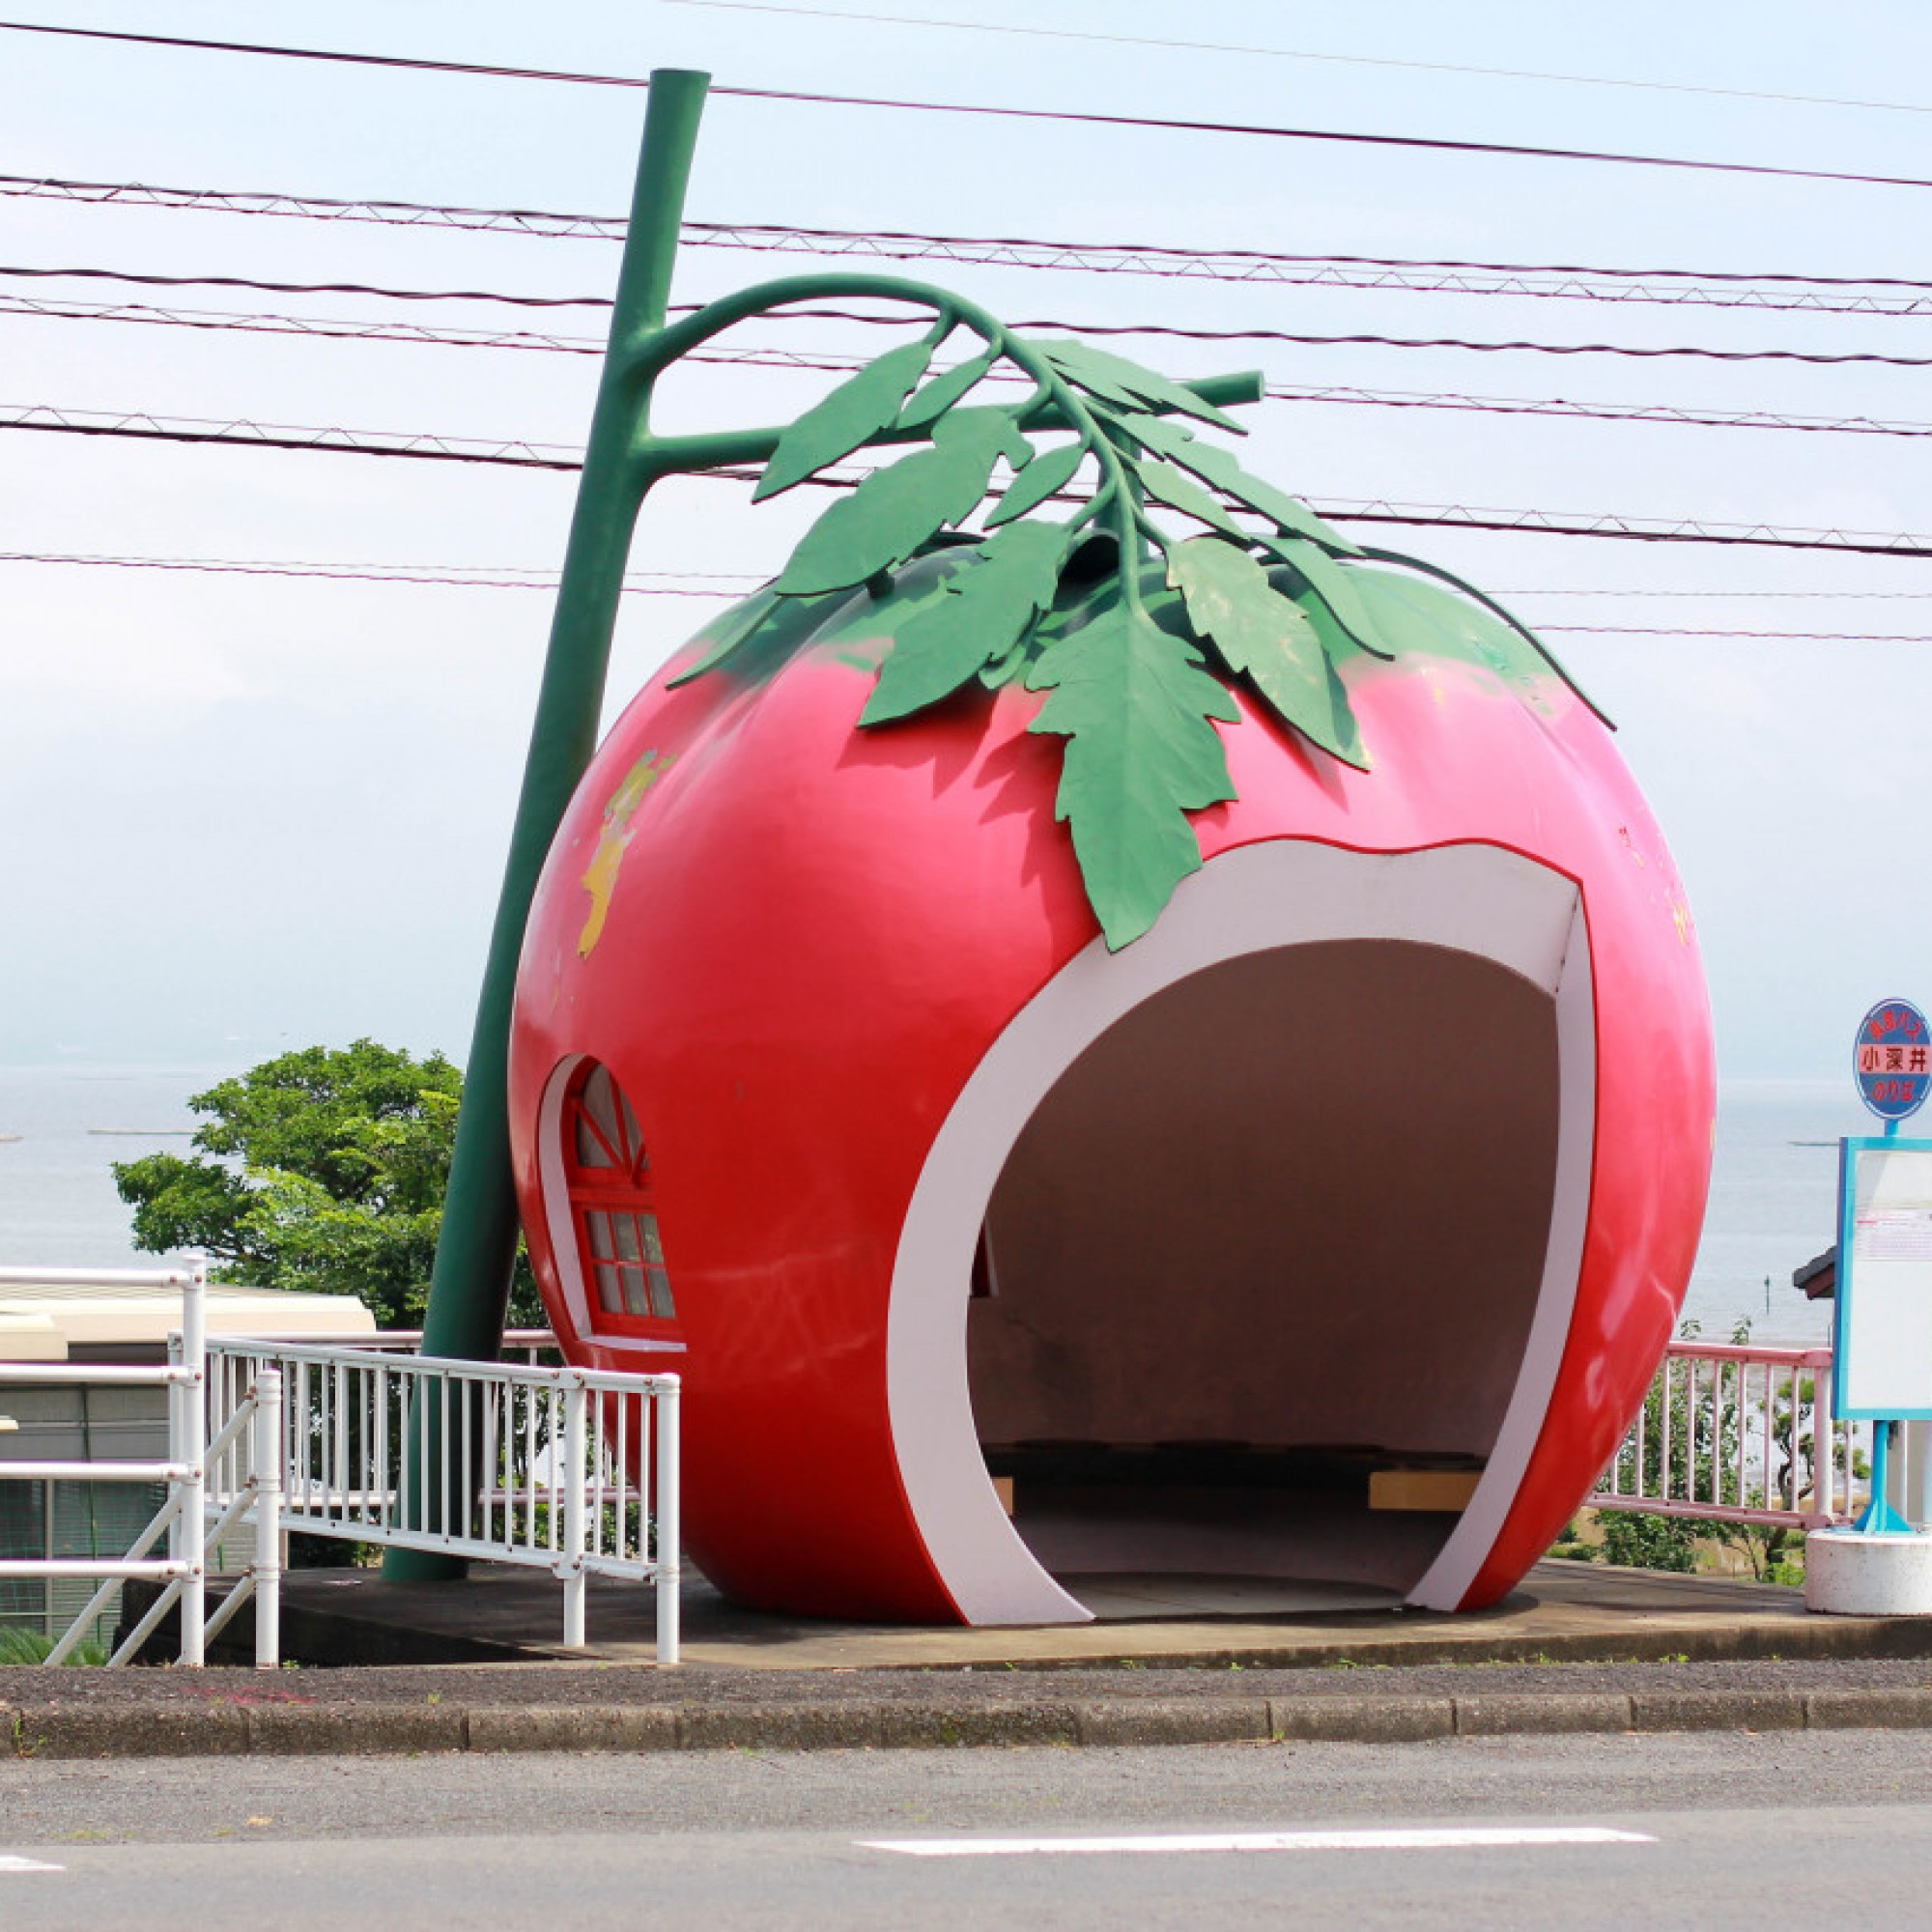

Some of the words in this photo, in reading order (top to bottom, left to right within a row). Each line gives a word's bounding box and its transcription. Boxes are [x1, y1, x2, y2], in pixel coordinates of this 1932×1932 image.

[1863, 1046, 1925, 1071] 小深井
[1874, 1080, 1913, 1101] のりば
